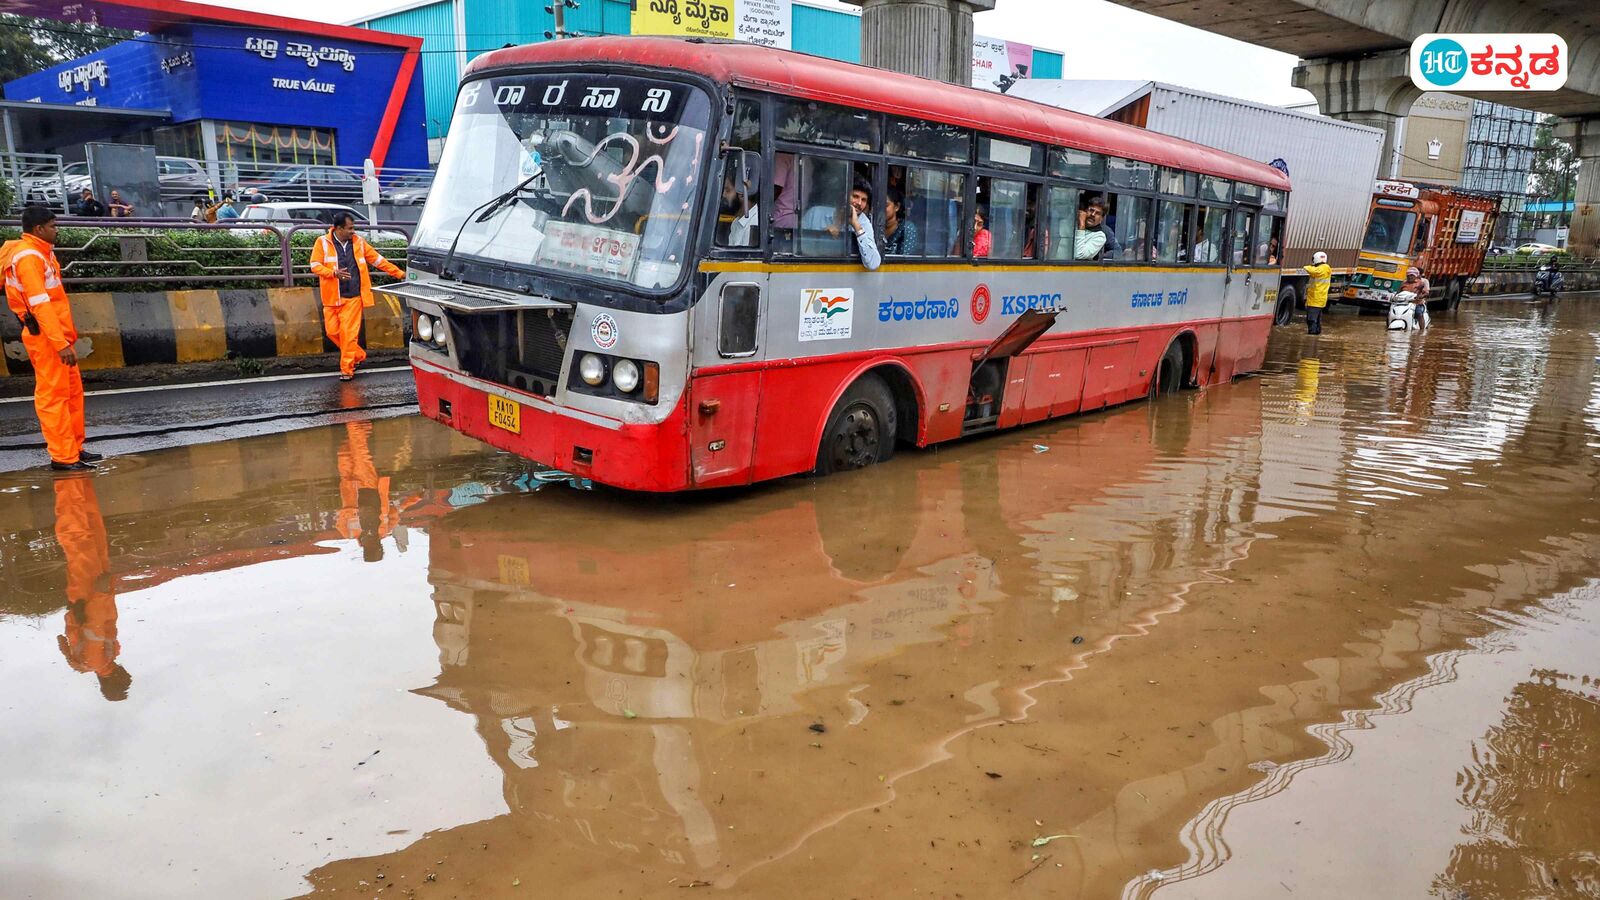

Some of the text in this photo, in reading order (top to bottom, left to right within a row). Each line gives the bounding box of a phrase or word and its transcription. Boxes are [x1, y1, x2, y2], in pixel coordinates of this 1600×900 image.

[272, 78, 335, 94] TRUE VALUE
[878, 294, 960, 322] ಕರಾರಸಾನಿ
[1001, 293, 1062, 315] KSRTC
[496, 400, 514, 415] KA10
[494, 411, 516, 429] F0454
